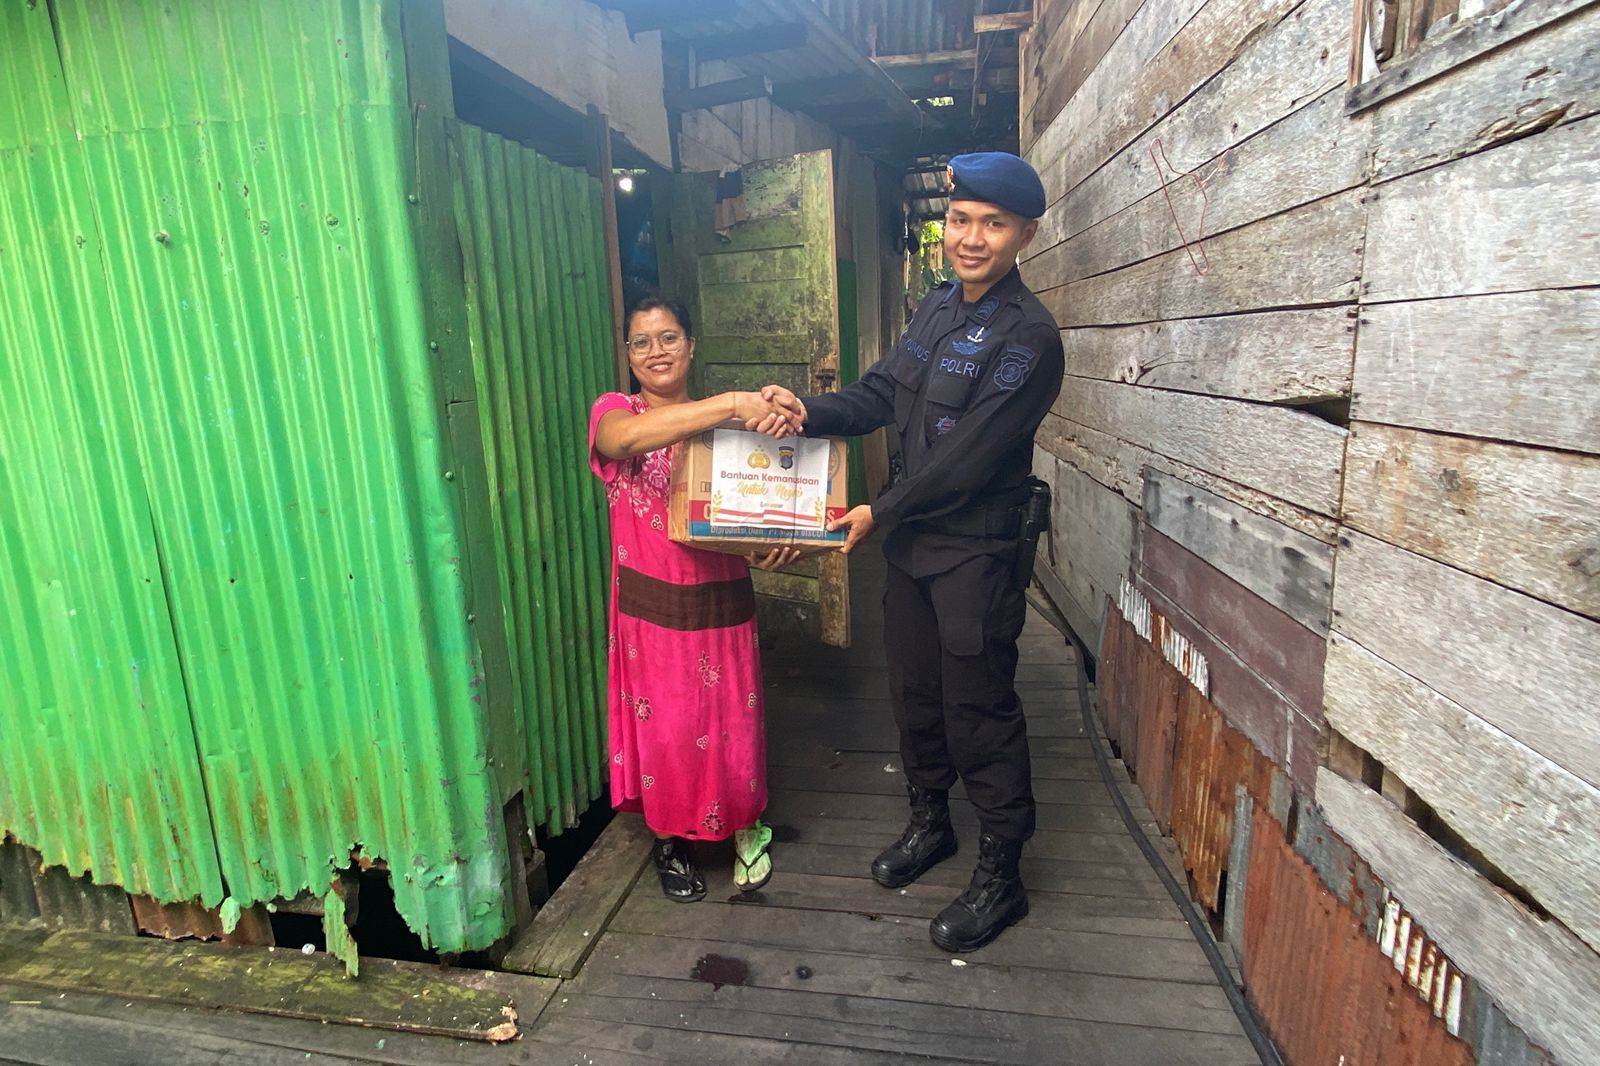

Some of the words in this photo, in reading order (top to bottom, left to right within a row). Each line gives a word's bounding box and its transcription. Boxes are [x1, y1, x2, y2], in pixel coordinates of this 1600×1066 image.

[939, 358, 980, 379] POLRI
[720, 470, 760, 482] Bantuan
[761, 473, 820, 486] Kemanusiaan
